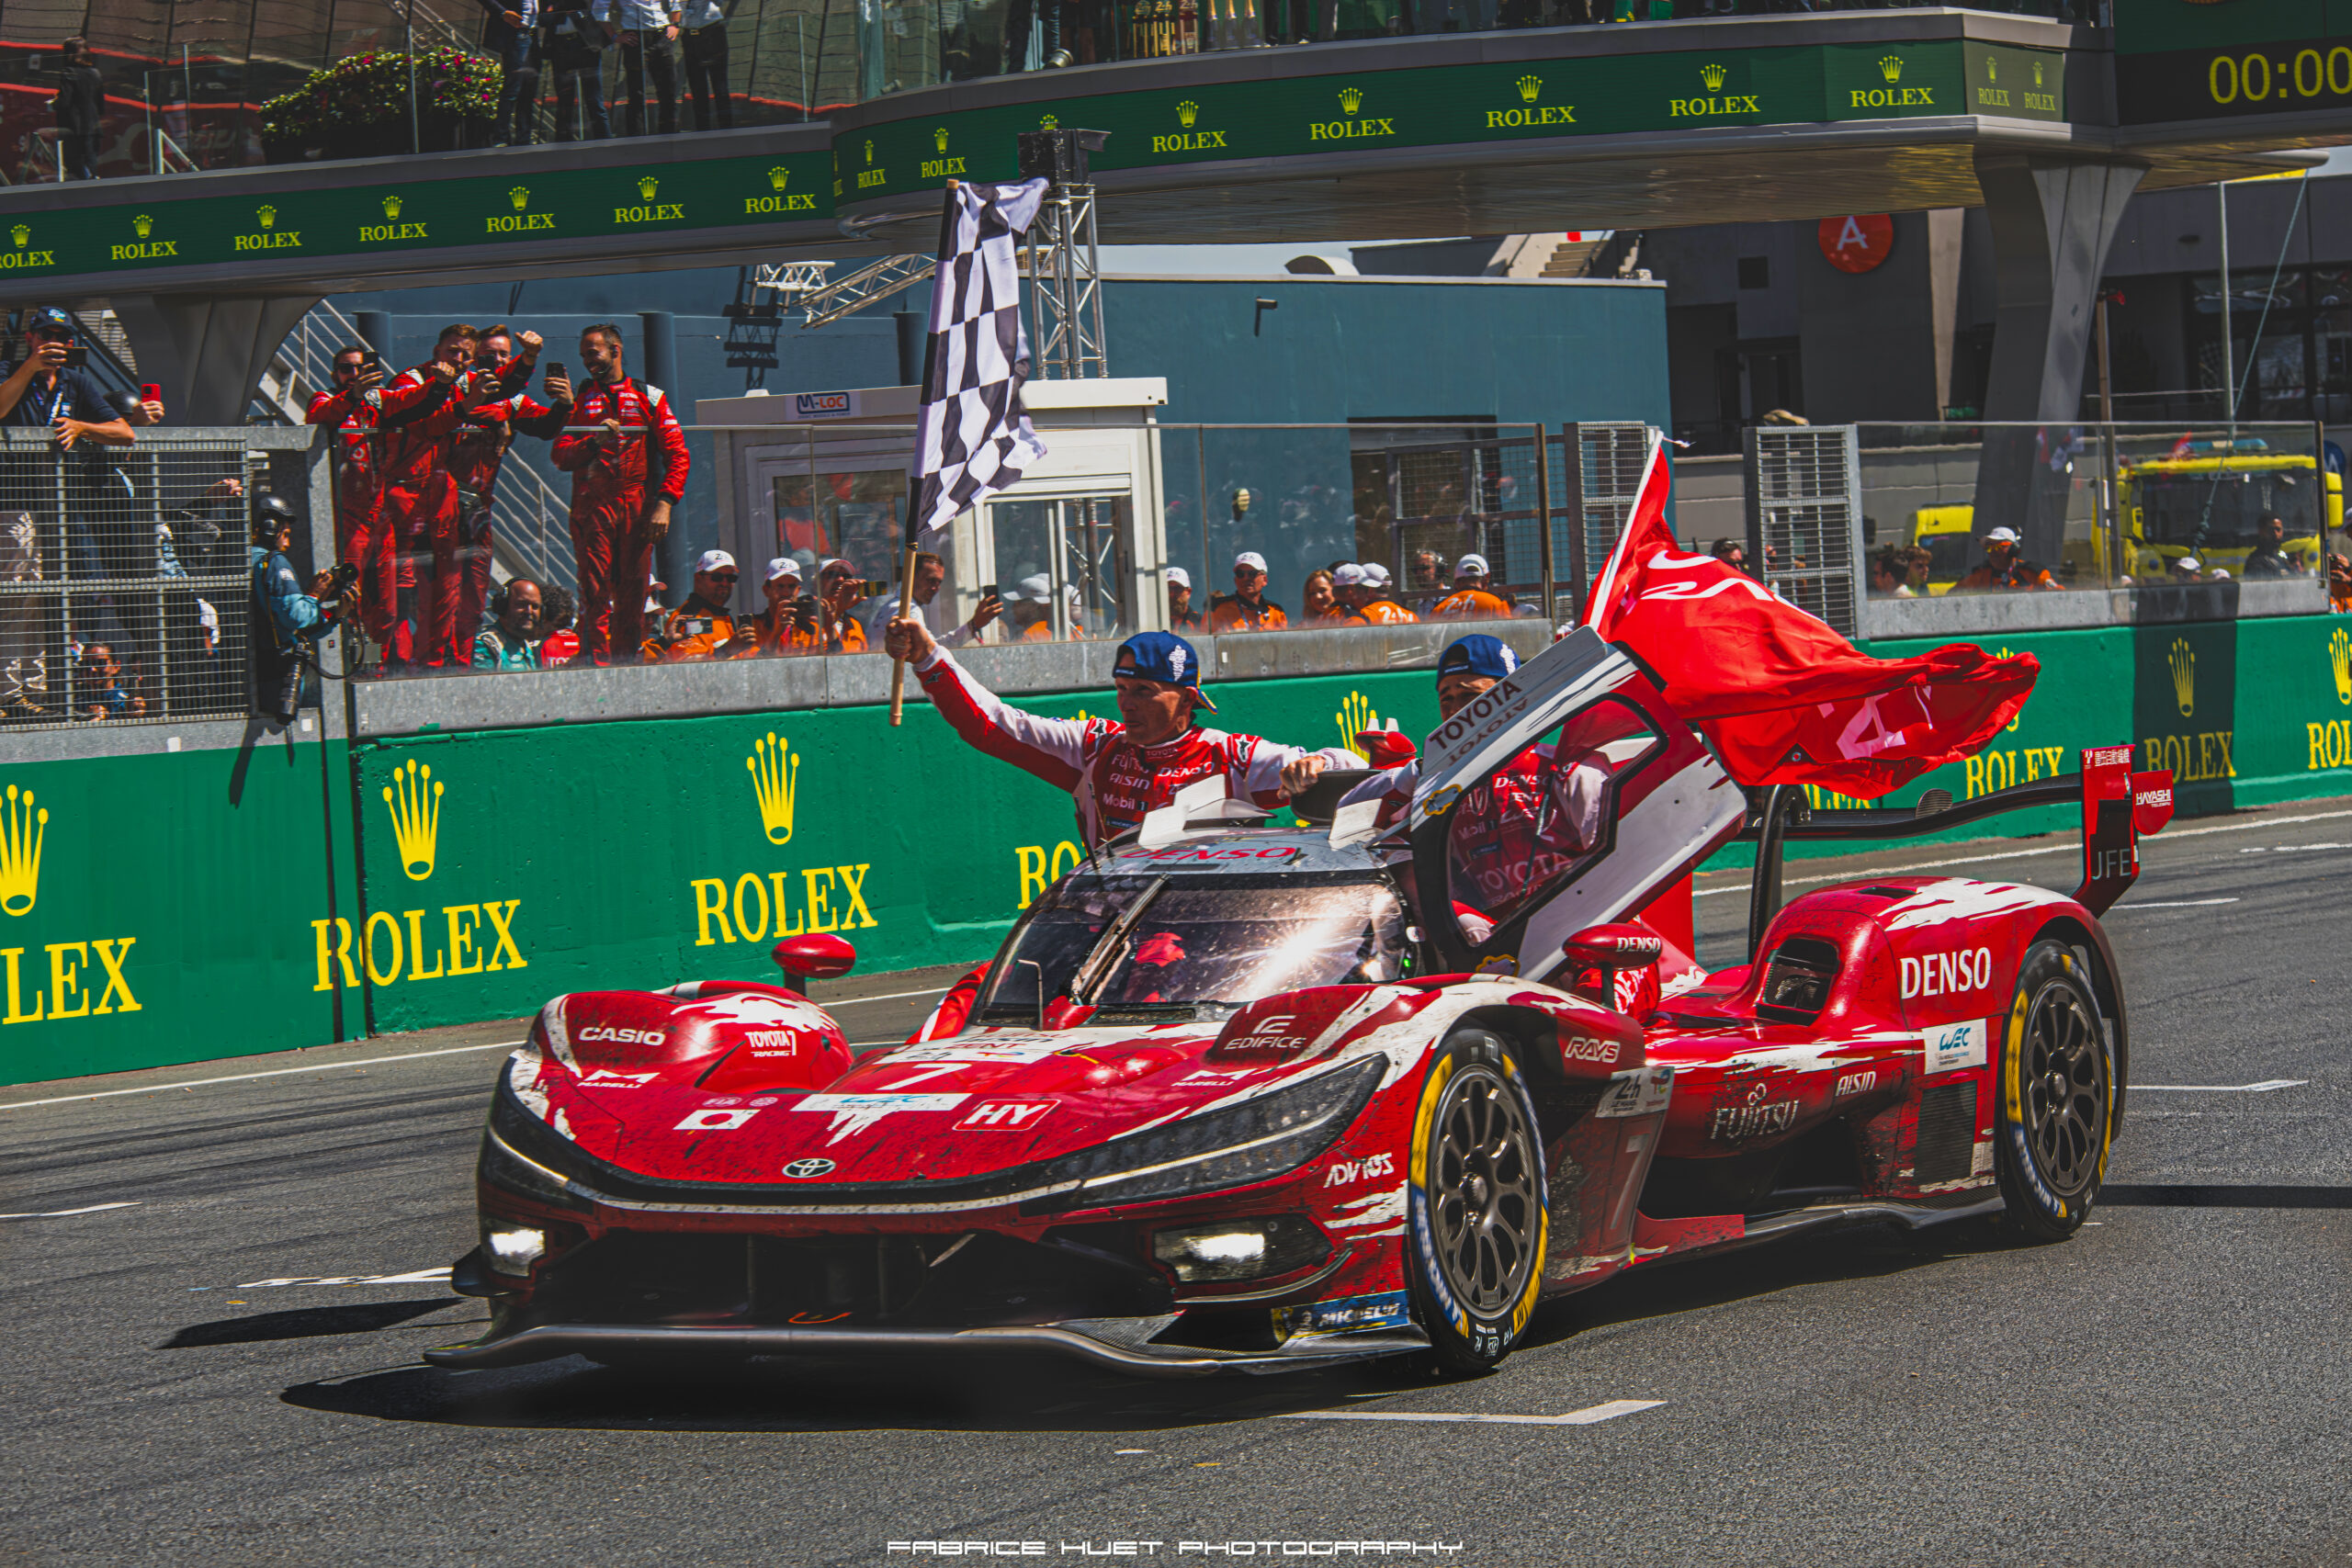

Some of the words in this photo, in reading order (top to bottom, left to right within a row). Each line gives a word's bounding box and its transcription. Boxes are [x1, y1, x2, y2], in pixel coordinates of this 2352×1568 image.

[2209, 46, 2352, 104] 00:00
[1669, 95, 1761, 117] ROLEX
[1850, 87, 1934, 107] ROLEX
[1978, 87, 2010, 107] ROLEX
[2024, 92, 2056, 111] ROLEX
[1486, 106, 1577, 129] ROLEX
[1309, 118, 1396, 141] ROLEX
[1151, 130, 1228, 152] ROLEX
[921, 156, 967, 178] ROLEX
[614, 203, 684, 223] ROLEX
[745, 193, 817, 214] ROLEX
[359, 222, 428, 242] ROLEX
[485, 213, 556, 233] ROLEX
[1837, 216, 1869, 251] A
[110, 241, 178, 261] ROLEX
[234, 231, 302, 251] ROLEX
[797, 393, 845, 411] M-LOC
[1429, 680, 1522, 750] TOYOTA
[2306, 719, 2352, 771] ROL
[2143, 731, 2236, 785] ROLEX
[1158, 761, 1216, 778] DENSO
[1964, 745, 2064, 801] ROLEX
[1109, 773, 1150, 790] AISIN
[1102, 793, 1136, 810] Mobil
[2135, 788, 2172, 806] HAYASHI
[1120, 847, 1296, 861] DENSO
[2091, 848, 2132, 881] JFE
[691, 863, 879, 947] ROLEX
[311, 898, 528, 991] ROLEX
[1615, 937, 1662, 953] DENSO
[0, 937, 142, 1025] LEX
[1900, 947, 1992, 1000] DENSO
[579, 1026, 667, 1046] CASIO
[744, 1030, 791, 1048] TOYOTA
[1223, 1035, 1307, 1051] EDIFICE
[1939, 1026, 1972, 1052] WEC
[1565, 1036, 1621, 1064] RAYS
[577, 1081, 643, 1090] MARELLI
[874, 1063, 973, 1091] 7
[1170, 1079, 1235, 1088] MARELLI
[1836, 1070, 1877, 1098] AISIN
[962, 1104, 1048, 1125] HY
[1711, 1099, 1799, 1140] FUJITSU
[1610, 1134, 1651, 1230] 7
